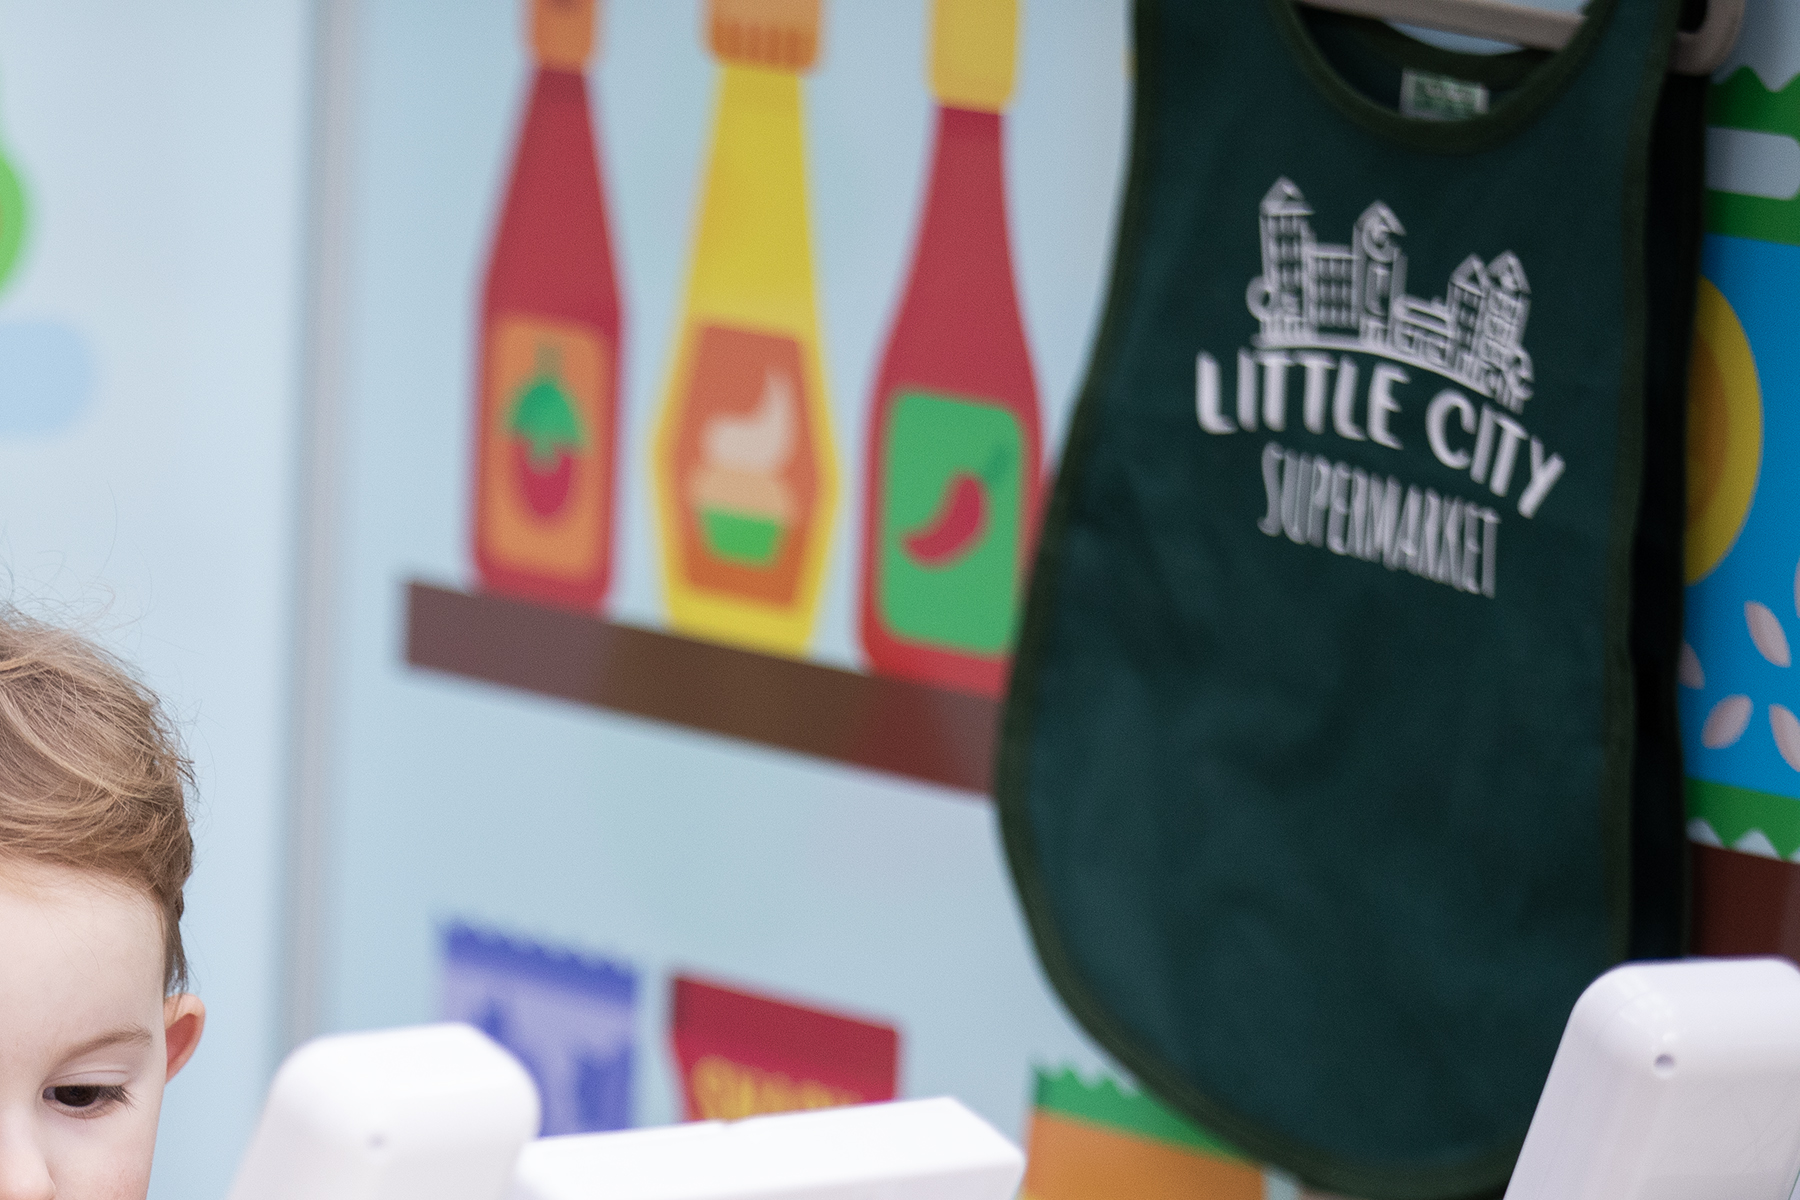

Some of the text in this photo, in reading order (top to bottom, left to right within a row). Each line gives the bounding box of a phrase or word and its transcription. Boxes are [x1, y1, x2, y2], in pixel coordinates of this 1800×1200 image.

[1195, 347, 1566, 519] LITTLE CITY
[1256, 440, 1501, 599] SUPERMARKET
